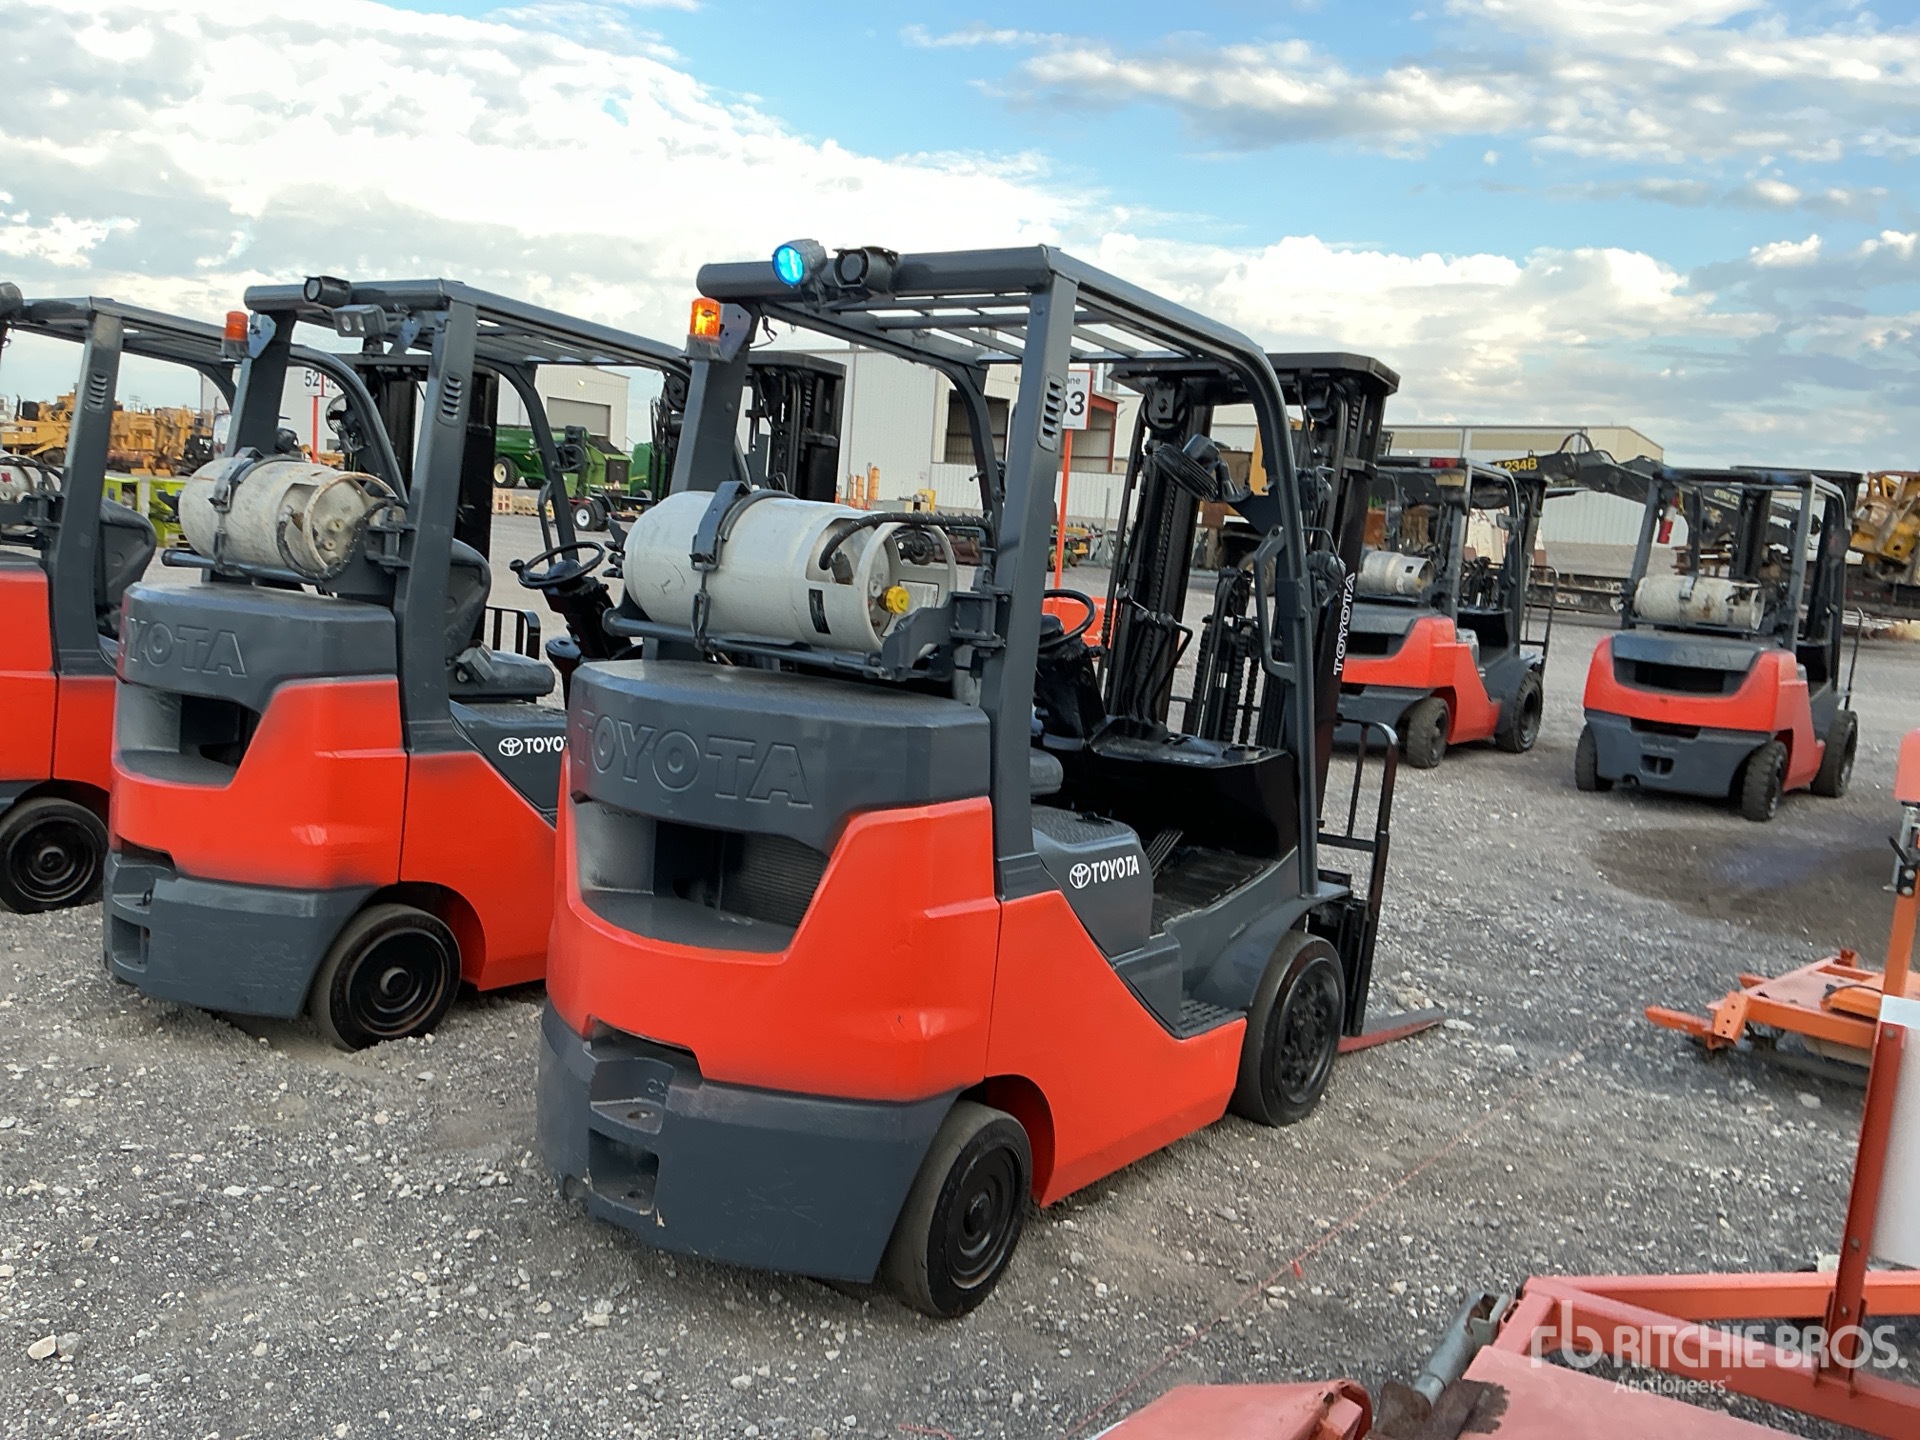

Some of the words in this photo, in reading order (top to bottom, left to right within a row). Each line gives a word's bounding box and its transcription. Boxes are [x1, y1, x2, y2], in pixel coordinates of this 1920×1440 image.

[304, 370, 320, 388] 52
[1064, 390, 1086, 417] 3
[1333, 572, 1356, 676] TOYOTA
[523, 735, 568, 754] TOYO
[578, 708, 814, 810] TOYOTA
[1090, 854, 1140, 884] TOYOTA
